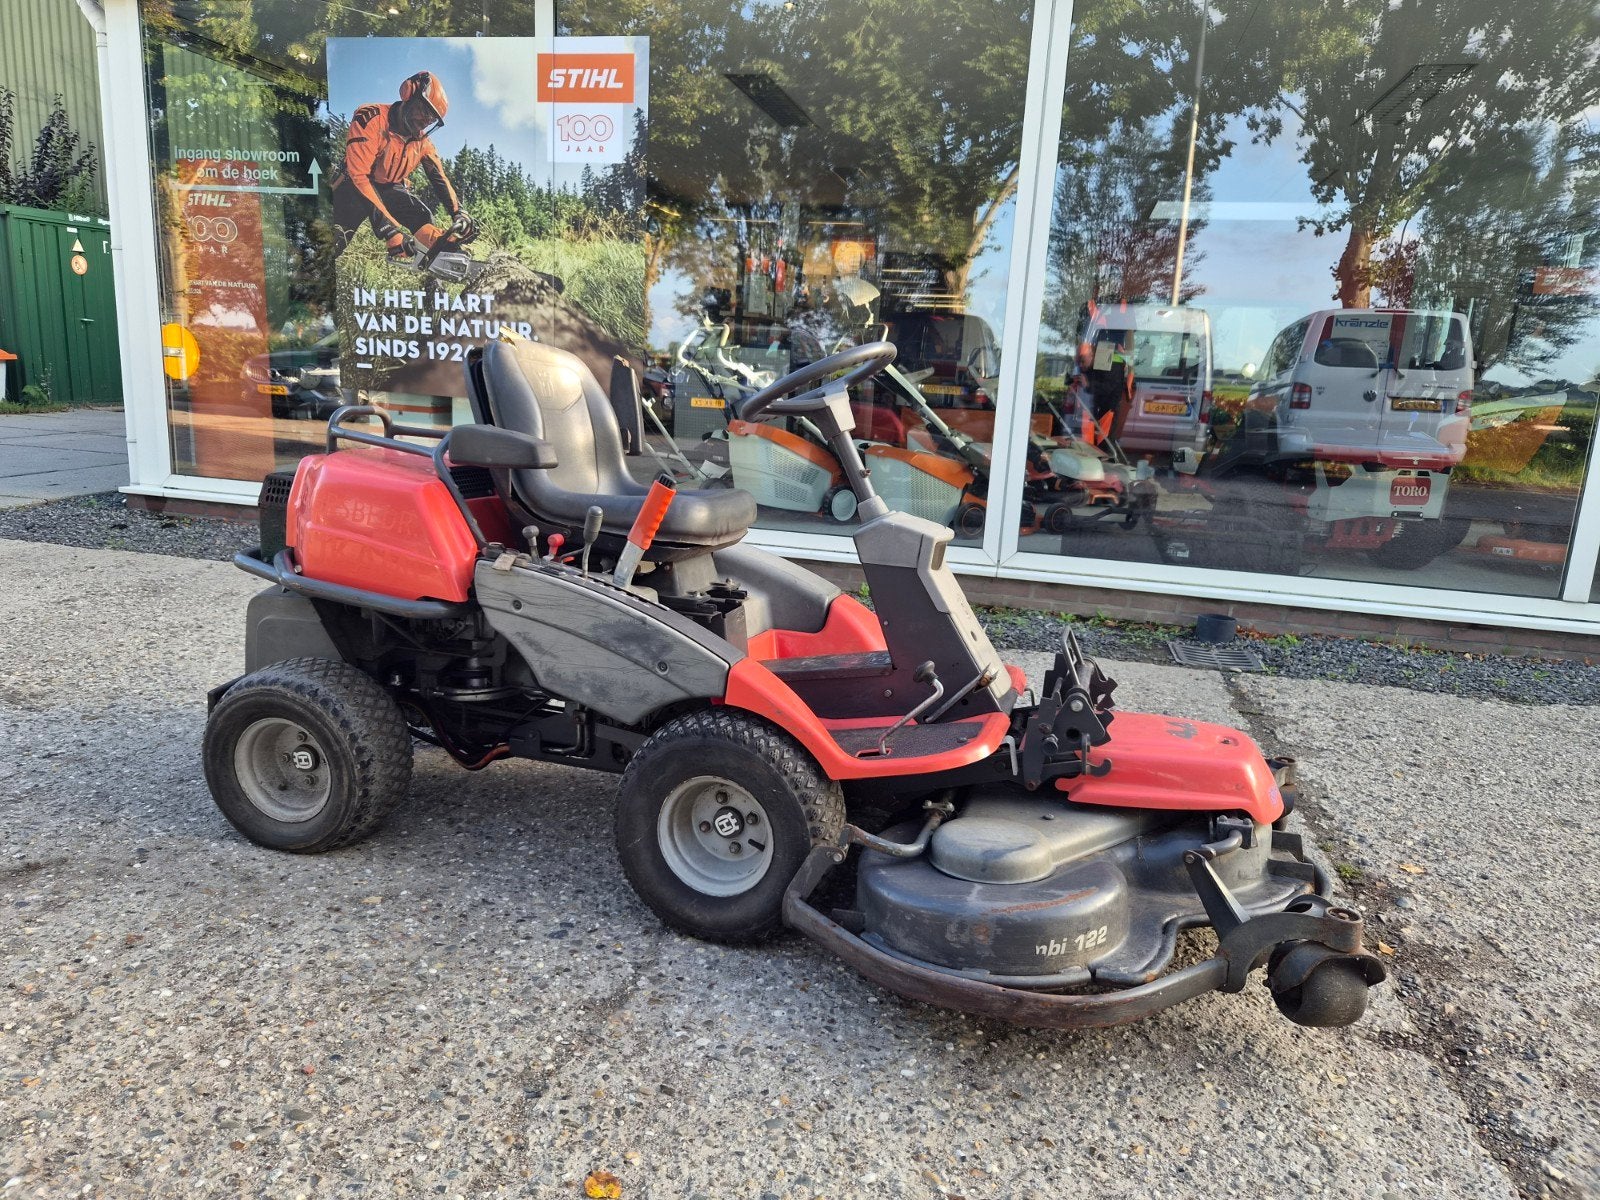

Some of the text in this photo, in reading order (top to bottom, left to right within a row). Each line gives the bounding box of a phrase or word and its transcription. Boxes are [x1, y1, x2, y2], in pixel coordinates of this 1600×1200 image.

[547, 68, 624, 89] STIHL
[556, 114, 614, 142] 100
[174, 146, 300, 163] Ingang showroom
[566, 145, 605, 153] JAAR
[196, 165, 278, 180] om de hoek
[354, 288, 495, 314] IN HET HART
[354, 312, 397, 332] VAN
[405, 315, 433, 335] DE
[355, 337, 420, 360] SINDS
[1074, 925, 1108, 951] 122
